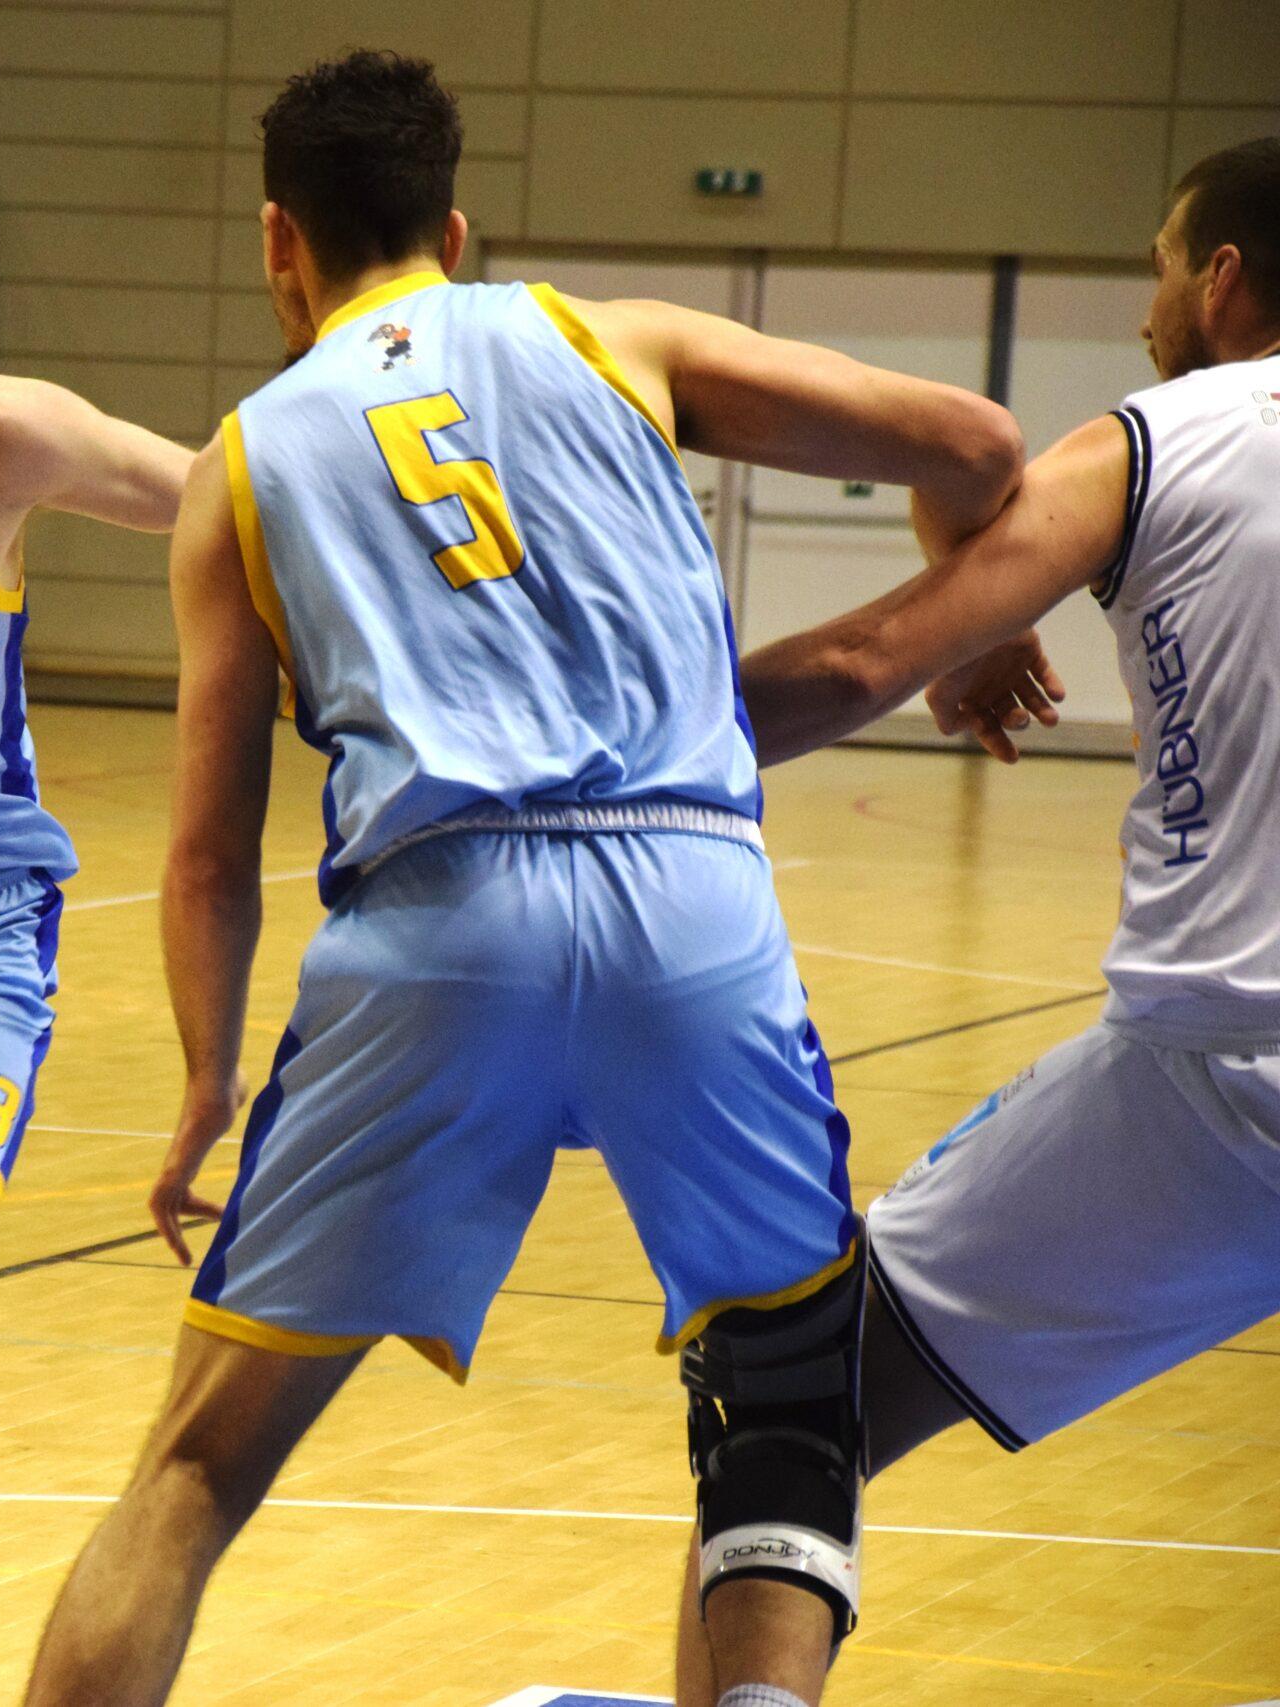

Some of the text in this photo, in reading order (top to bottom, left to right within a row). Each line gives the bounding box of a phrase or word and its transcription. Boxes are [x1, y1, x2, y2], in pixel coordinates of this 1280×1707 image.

[362, 388, 525, 591] 5
[1141, 596, 1209, 868] HÜBNER
[723, 1542, 816, 1560] DONJOY
